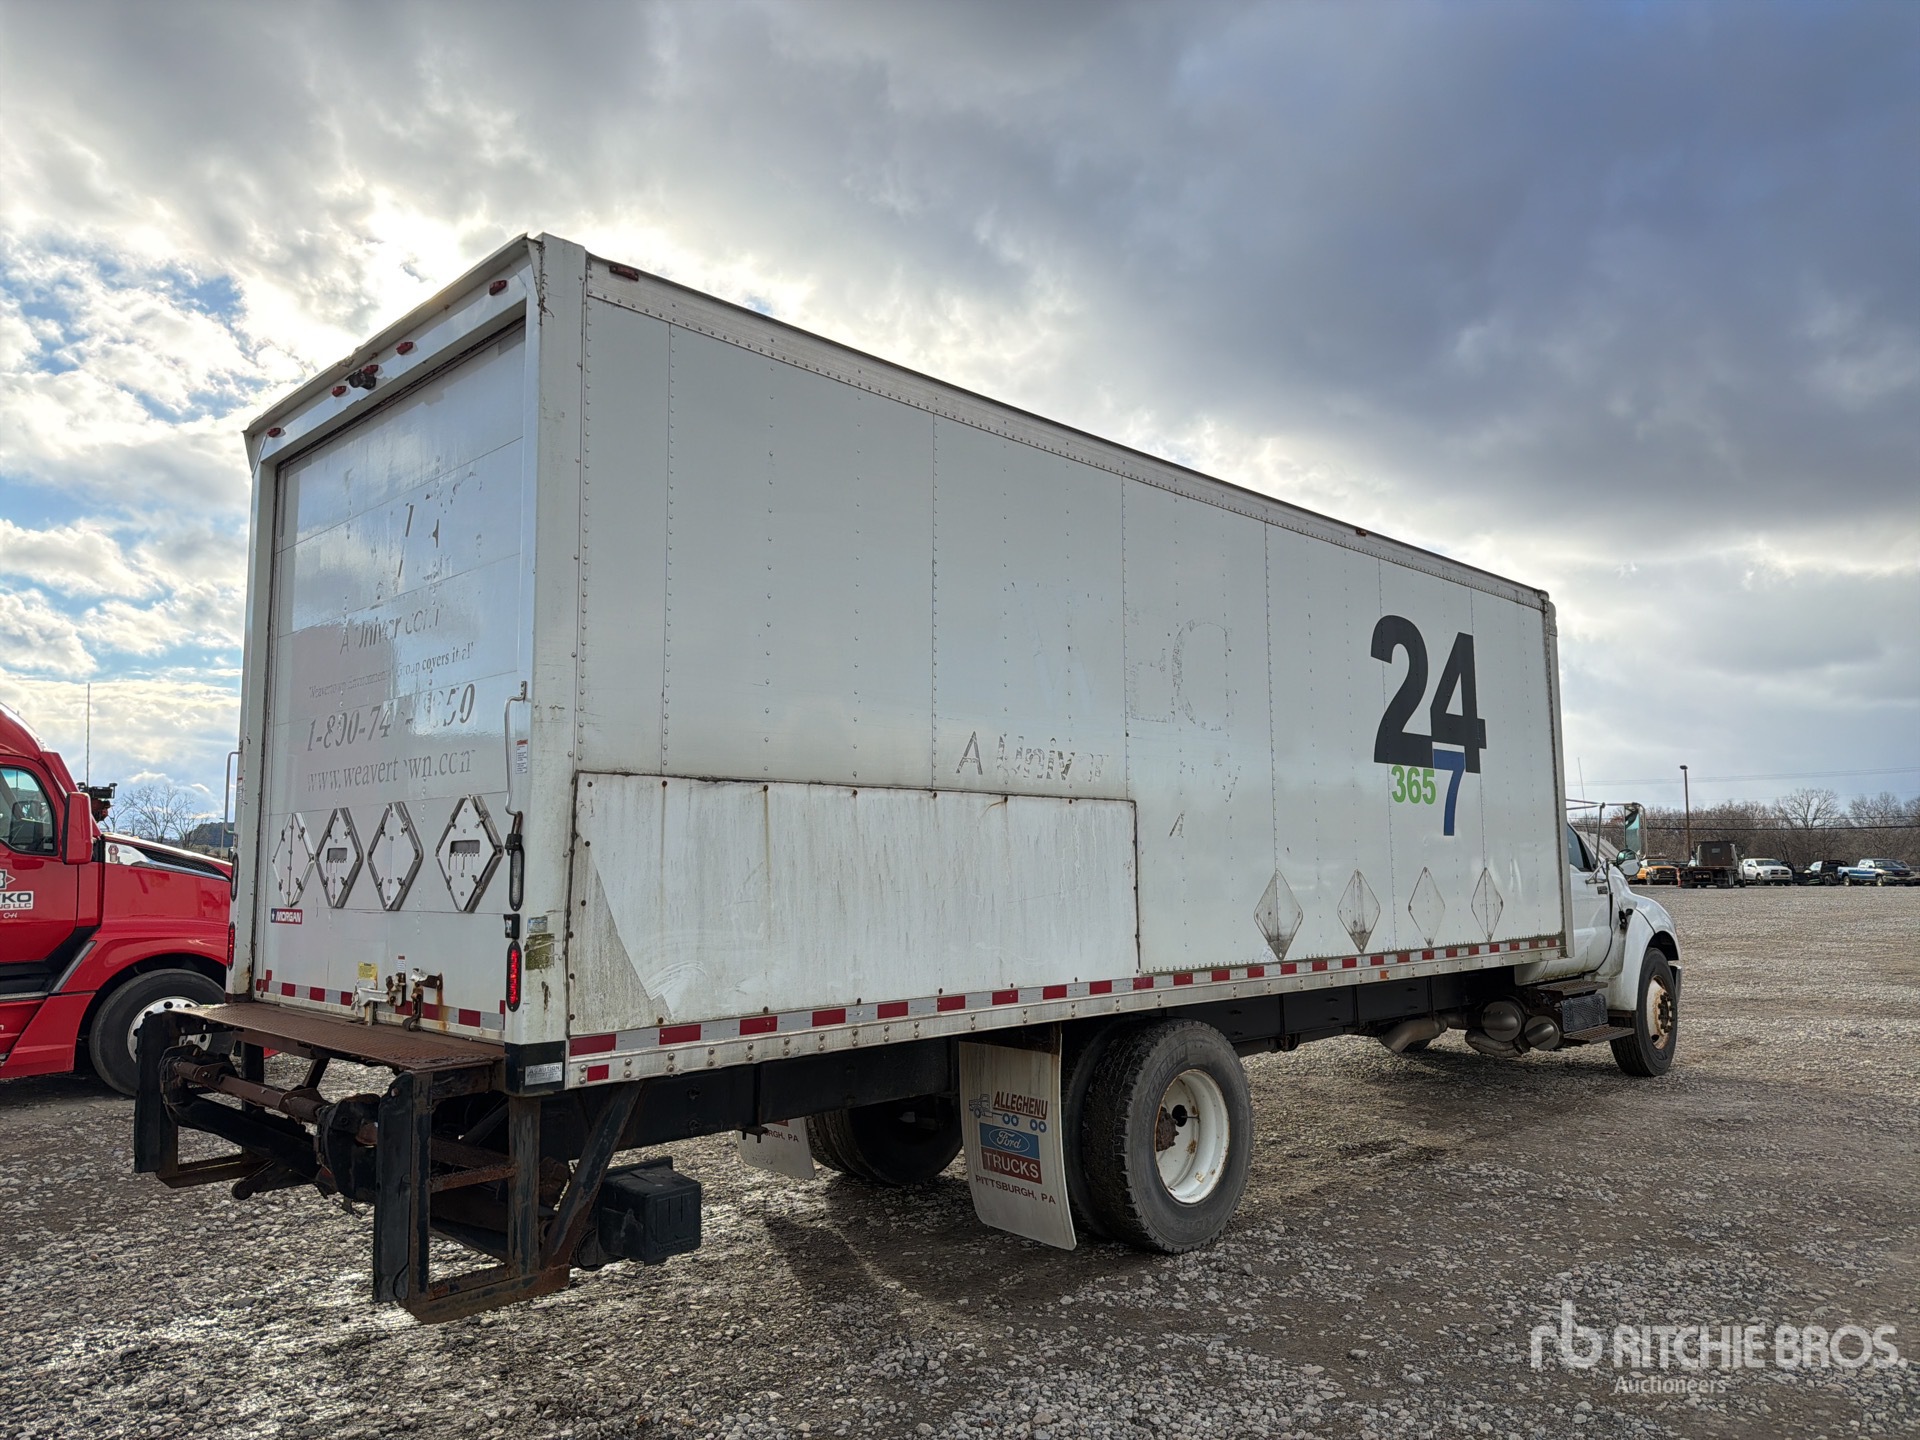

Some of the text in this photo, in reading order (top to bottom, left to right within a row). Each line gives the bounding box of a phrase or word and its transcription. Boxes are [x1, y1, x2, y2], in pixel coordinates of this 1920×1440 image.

[422, 652, 450, 670] covers
[1370, 614, 1488, 774] 24
[308, 750, 476, 793] www.weavertwn.com
[1391, 765, 1436, 804] 365
[1433, 748, 1465, 836] 7
[0, 893, 32, 903] KO
[276, 911, 302, 923] MORGAN
[993, 1090, 1048, 1120] ALLEGHENY
[787, 1133, 799, 1142] PA
[996, 1130, 1022, 1149] Ford
[983, 1151, 1040, 1179] TRUCKS
[975, 1174, 1056, 1205] PITTSBURGH, PA
